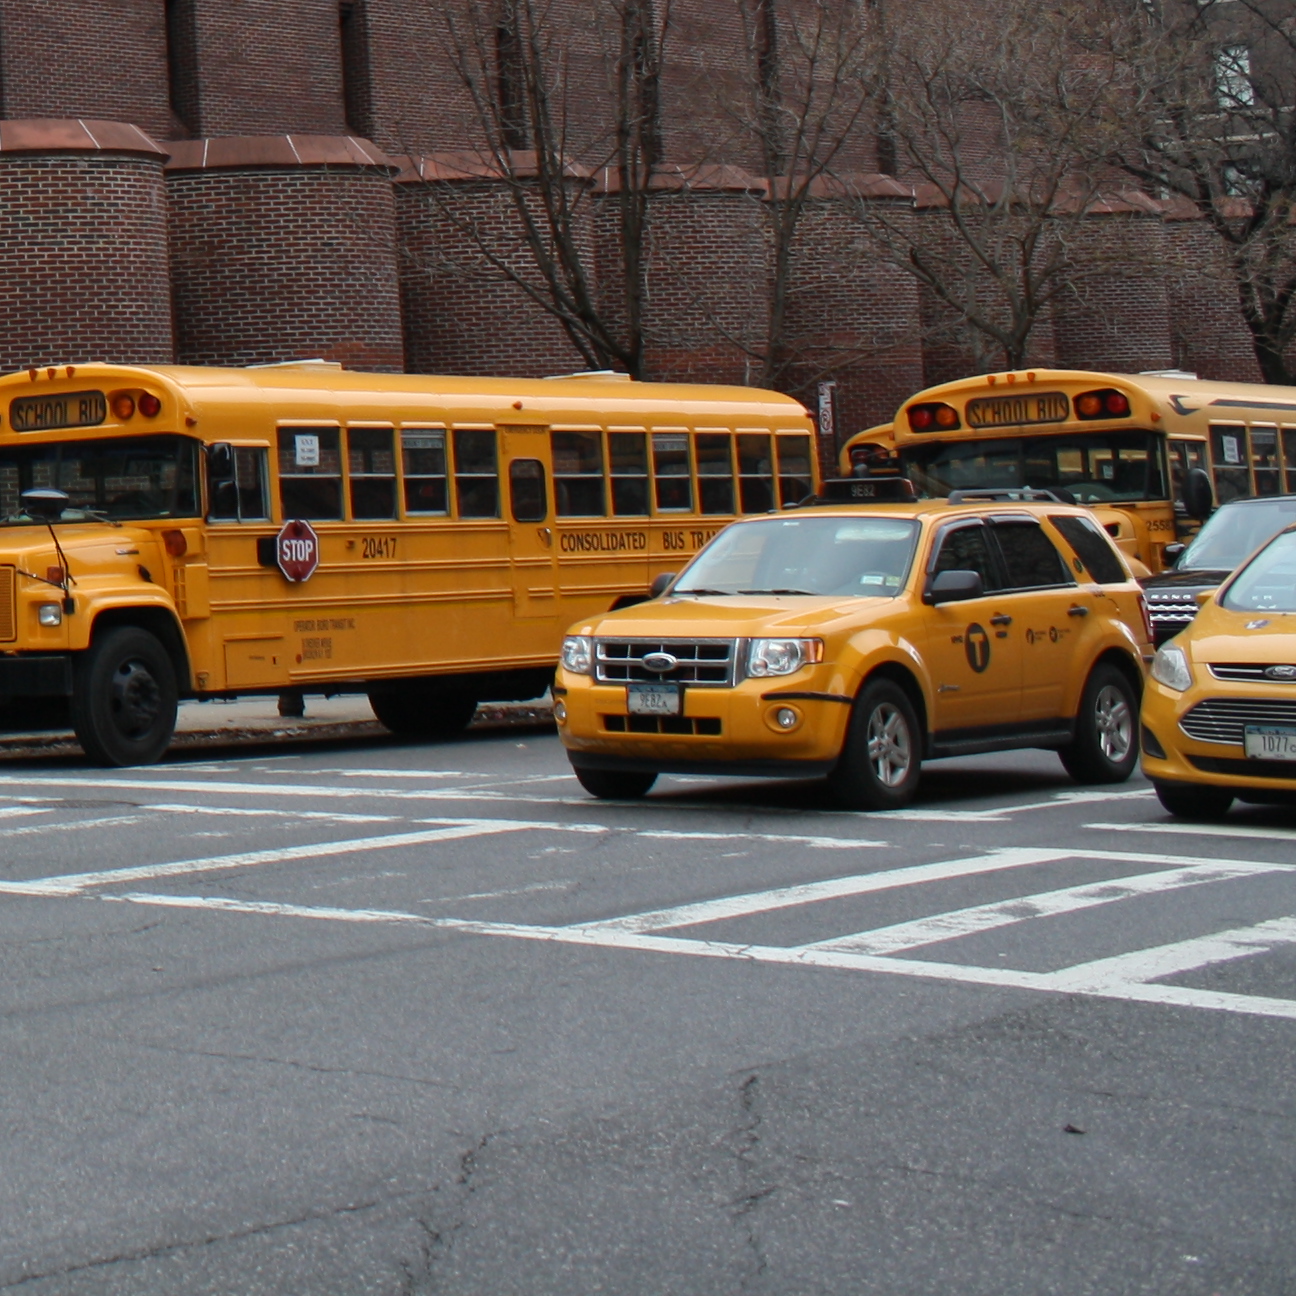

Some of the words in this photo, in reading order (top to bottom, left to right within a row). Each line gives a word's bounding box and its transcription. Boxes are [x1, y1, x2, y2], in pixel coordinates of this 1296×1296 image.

[17, 400, 69, 427] SCHOOL
[971, 399, 1028, 423] SCHOOL
[1036, 397, 1068, 420] BUS
[851, 485, 875, 497] 9E82
[282, 539, 313, 562] STOP
[362, 537, 397, 559] 20417
[560, 532, 646, 552] CONSOLIDATED
[663, 531, 685, 550] BUS
